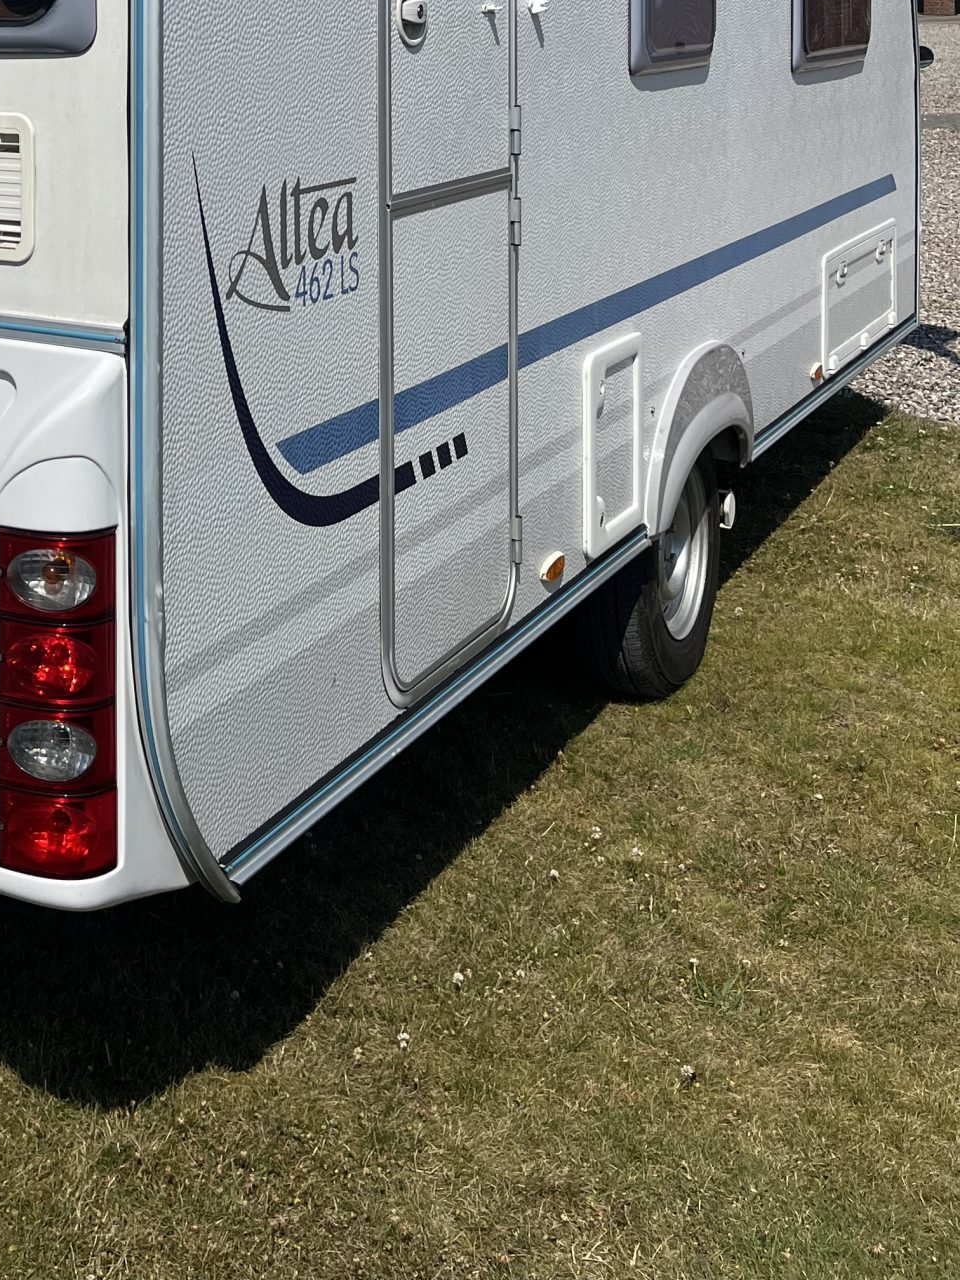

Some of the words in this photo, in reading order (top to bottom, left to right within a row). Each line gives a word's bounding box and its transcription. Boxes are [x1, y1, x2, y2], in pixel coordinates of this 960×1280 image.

[225, 176, 359, 312] Altea
[294, 258, 334, 307] 462
[340, 251, 360, 295] LS
